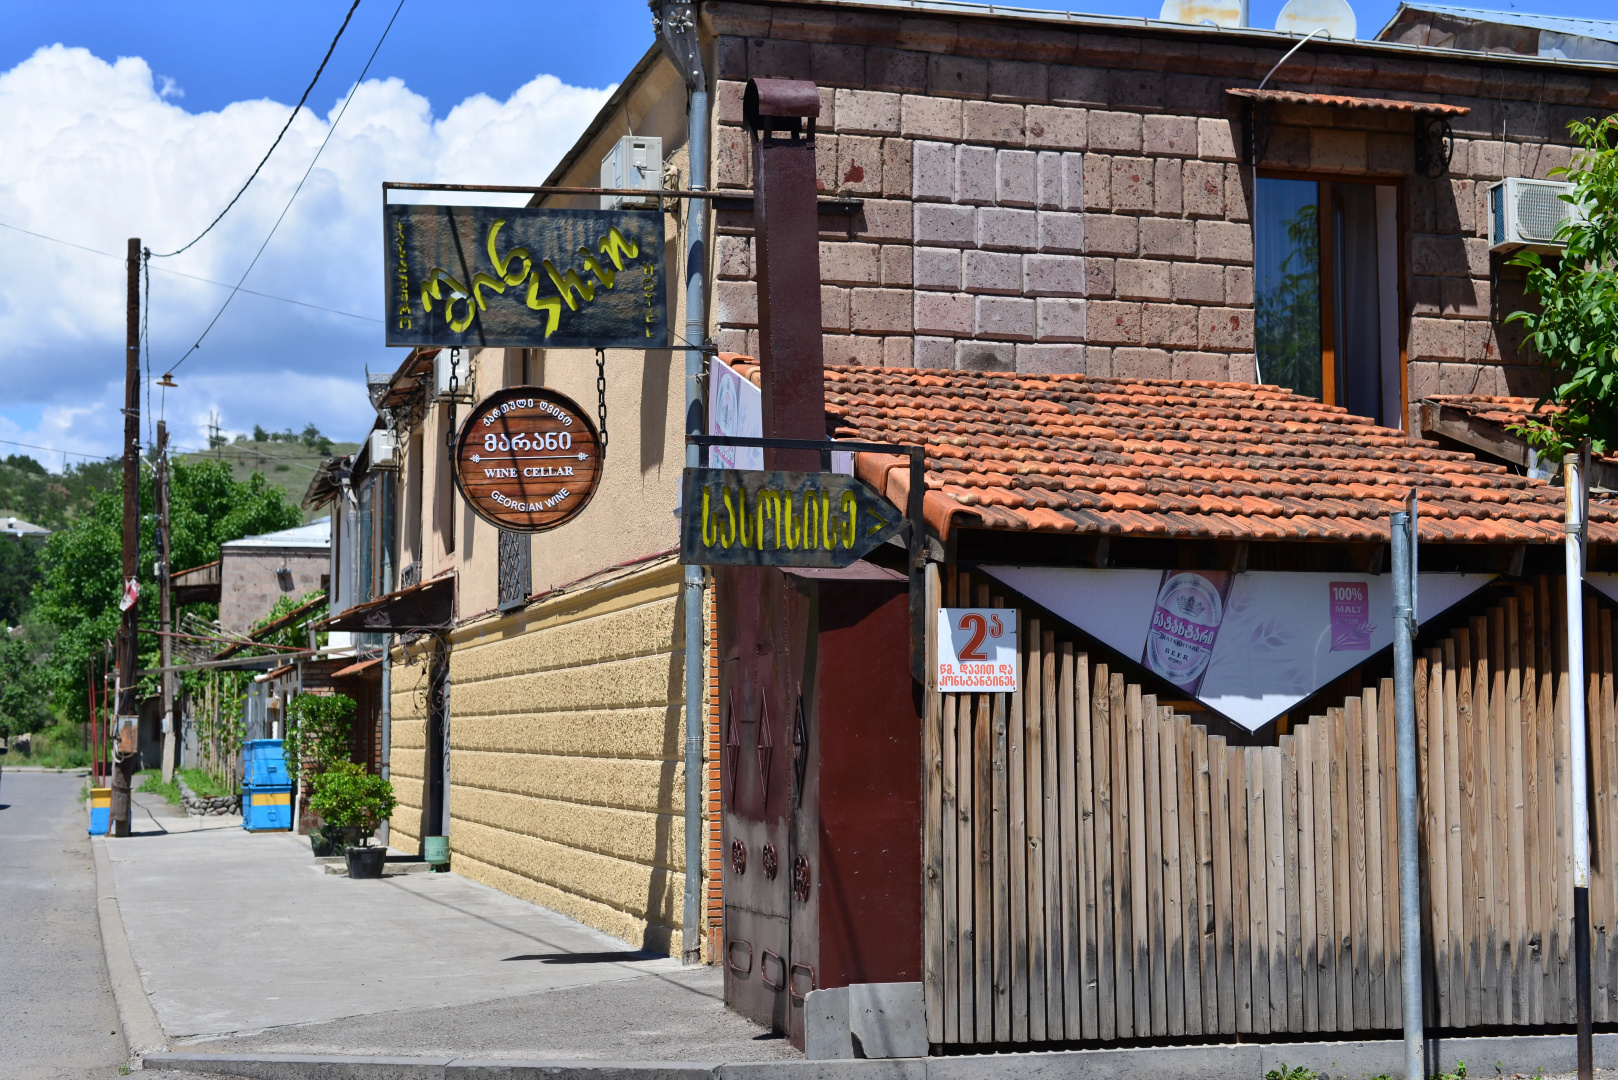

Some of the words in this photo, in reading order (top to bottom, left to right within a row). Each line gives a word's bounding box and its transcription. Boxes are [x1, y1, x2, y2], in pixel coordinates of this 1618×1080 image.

[643, 262, 655, 338] HOTEL
[484, 432, 571, 452] მარანი
[484, 468, 518, 478] WINE
[523, 466, 574, 477] CELLAR
[491, 490, 543, 512] GEORGIAN
[544, 487, 570, 508] WINE
[1333, 587, 1363, 600] 100%
[1165, 648, 1188, 660] BEER
[940, 664, 954, 674] წმ.
[960, 664, 994, 674] დავით
[999, 664, 1013, 674] და
[939, 676, 1016, 686] კონსტანტინეს
